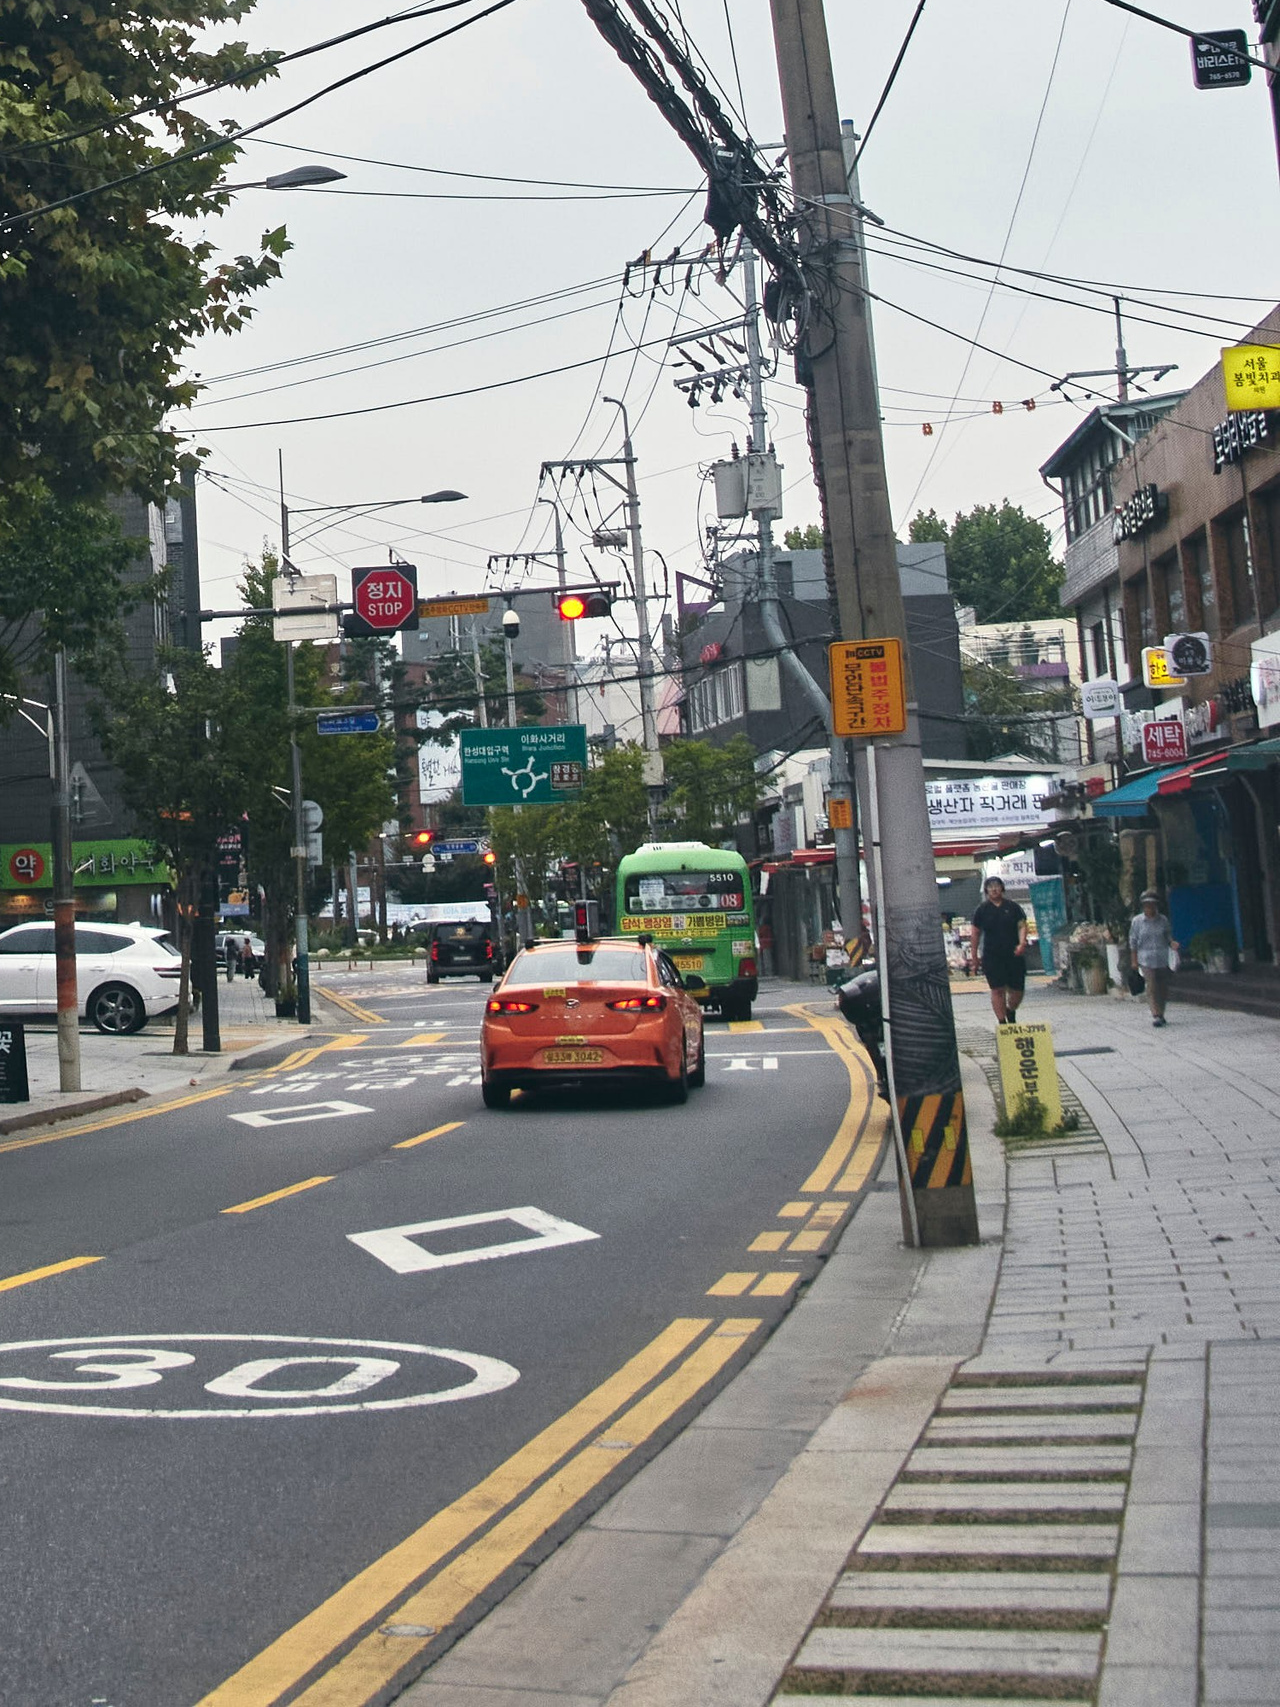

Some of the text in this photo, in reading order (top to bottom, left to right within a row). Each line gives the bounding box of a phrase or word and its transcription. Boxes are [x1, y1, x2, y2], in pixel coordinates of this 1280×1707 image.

[1243, 356, 1268, 371] 서울
[366, 581, 402, 599] 정지
[368, 602, 403, 616] STOP
[857, 648, 883, 658] CCTV
[870, 661, 891, 728] 불법주정차
[521, 733, 566, 744] 이화사거리
[1147, 725, 1181, 748] 세탁
[463, 745, 509, 757] 한성대입구역
[928, 796, 975, 815] 생산자
[979, 794, 1027, 812] 직거래
[15, 854, 38, 878] 약
[709, 873, 734, 882] 5510
[721, 894, 738, 907] 08
